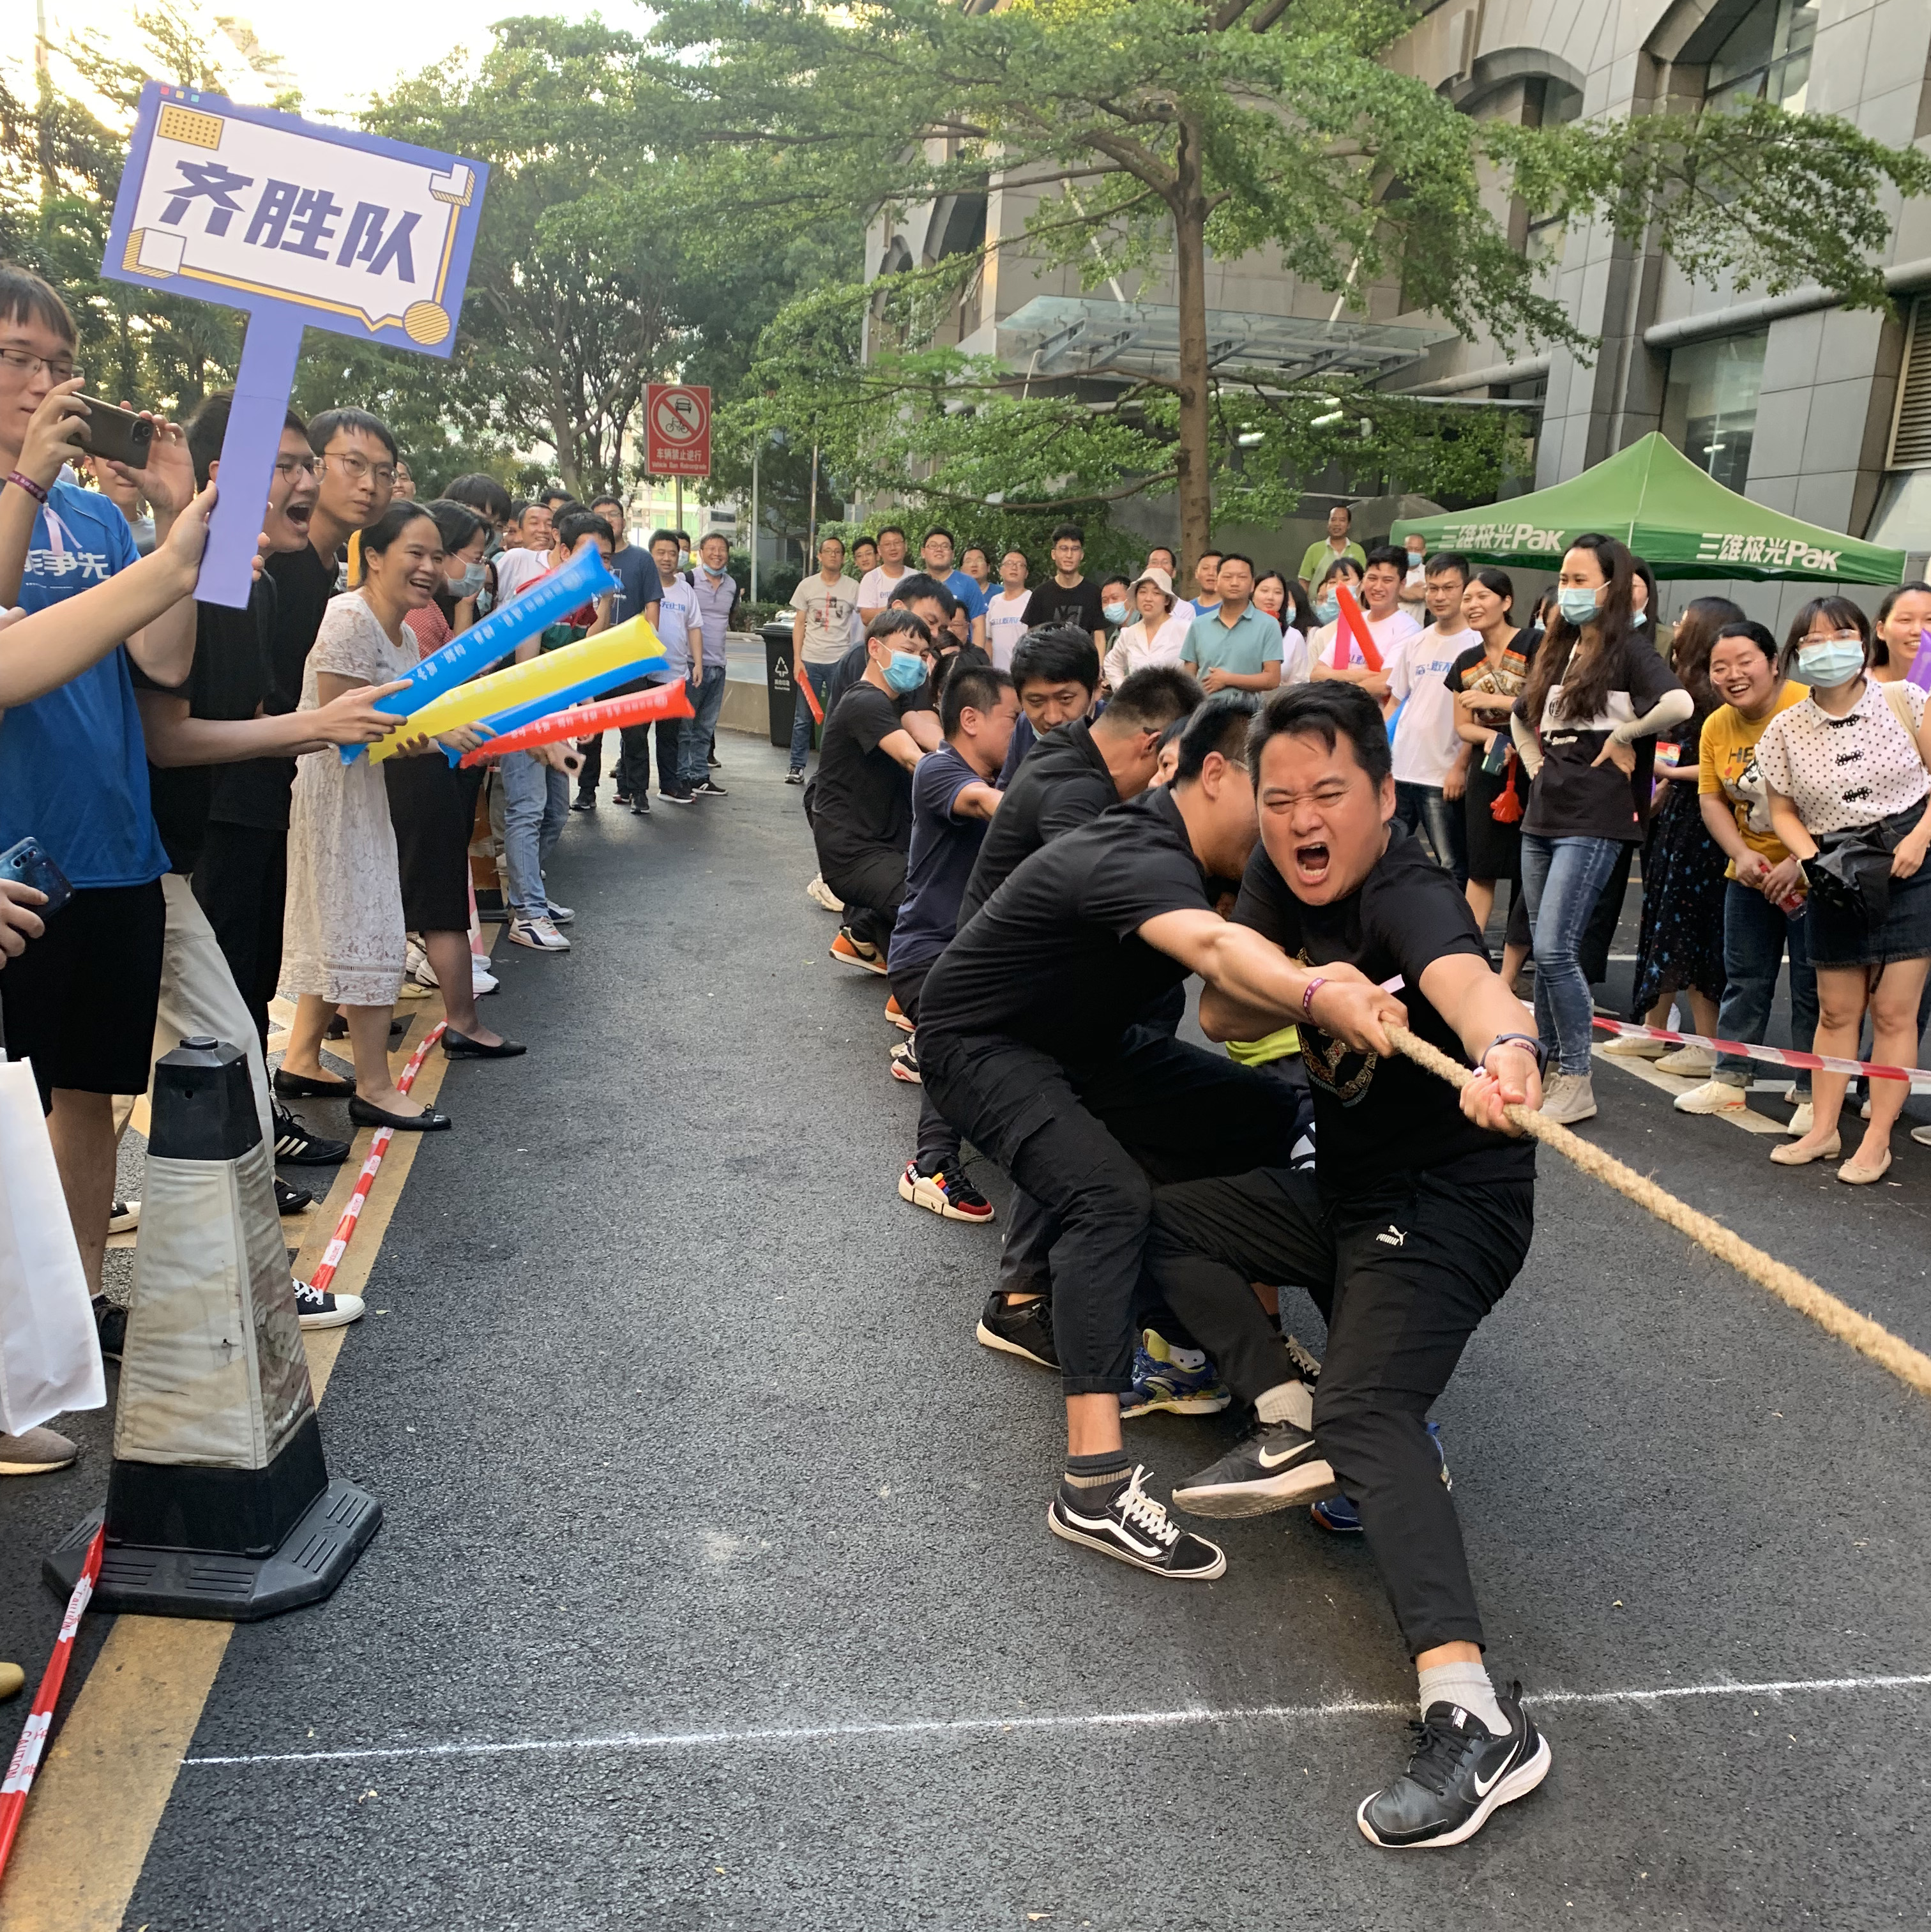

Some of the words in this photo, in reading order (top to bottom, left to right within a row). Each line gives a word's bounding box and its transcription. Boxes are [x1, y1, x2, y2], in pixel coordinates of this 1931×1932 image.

[158, 159, 423, 284] 齐胜队
[5, 1730, 33, 1781] CAUTION
